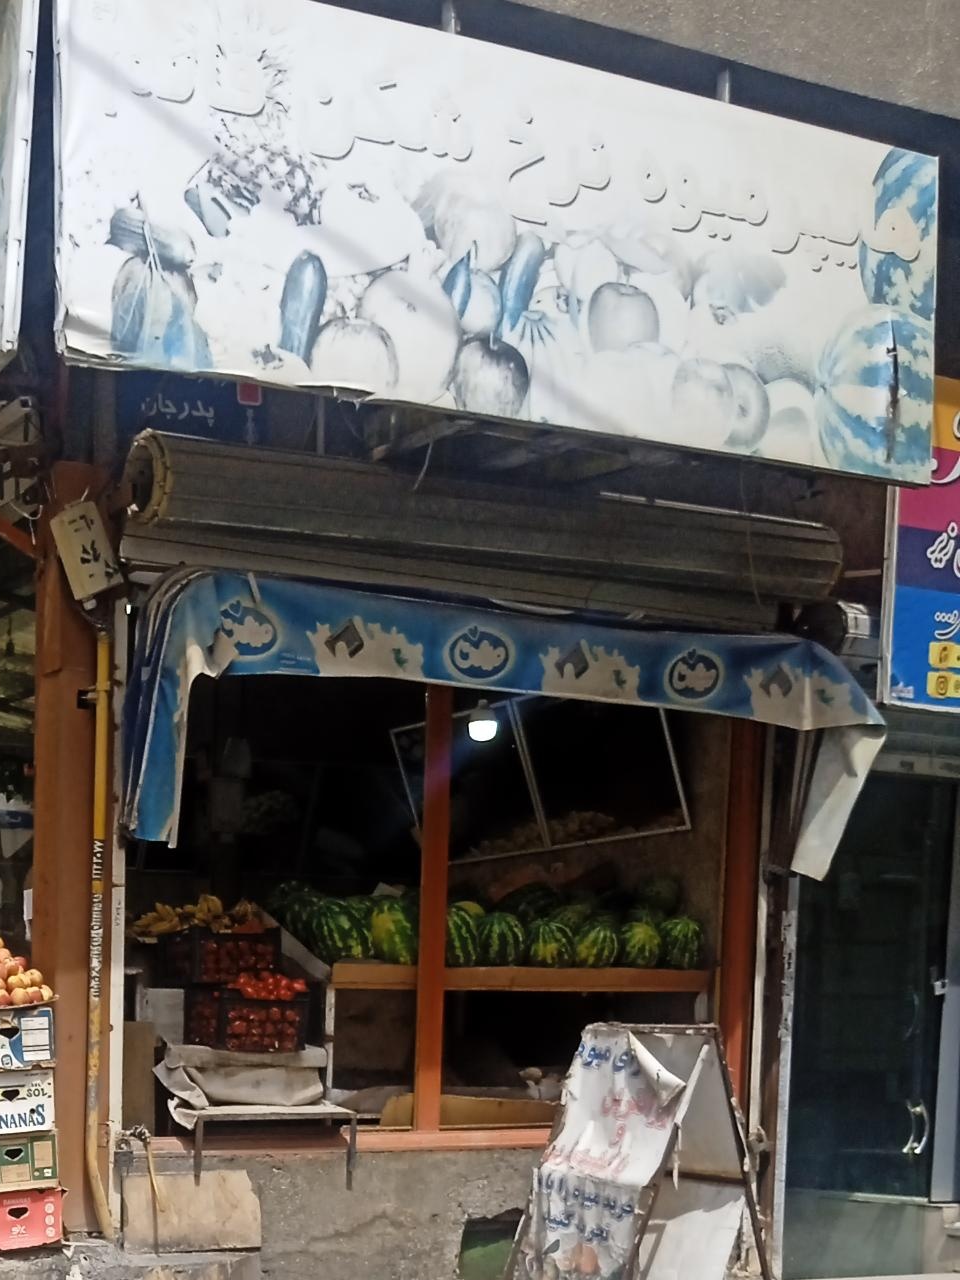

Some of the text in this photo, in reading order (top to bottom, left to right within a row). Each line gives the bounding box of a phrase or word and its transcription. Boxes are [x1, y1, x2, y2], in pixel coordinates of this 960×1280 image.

[502, 102, 612, 231] نرخ
[635, 148, 768, 242] میوه
[26, 1087, 48, 1098] SOL
